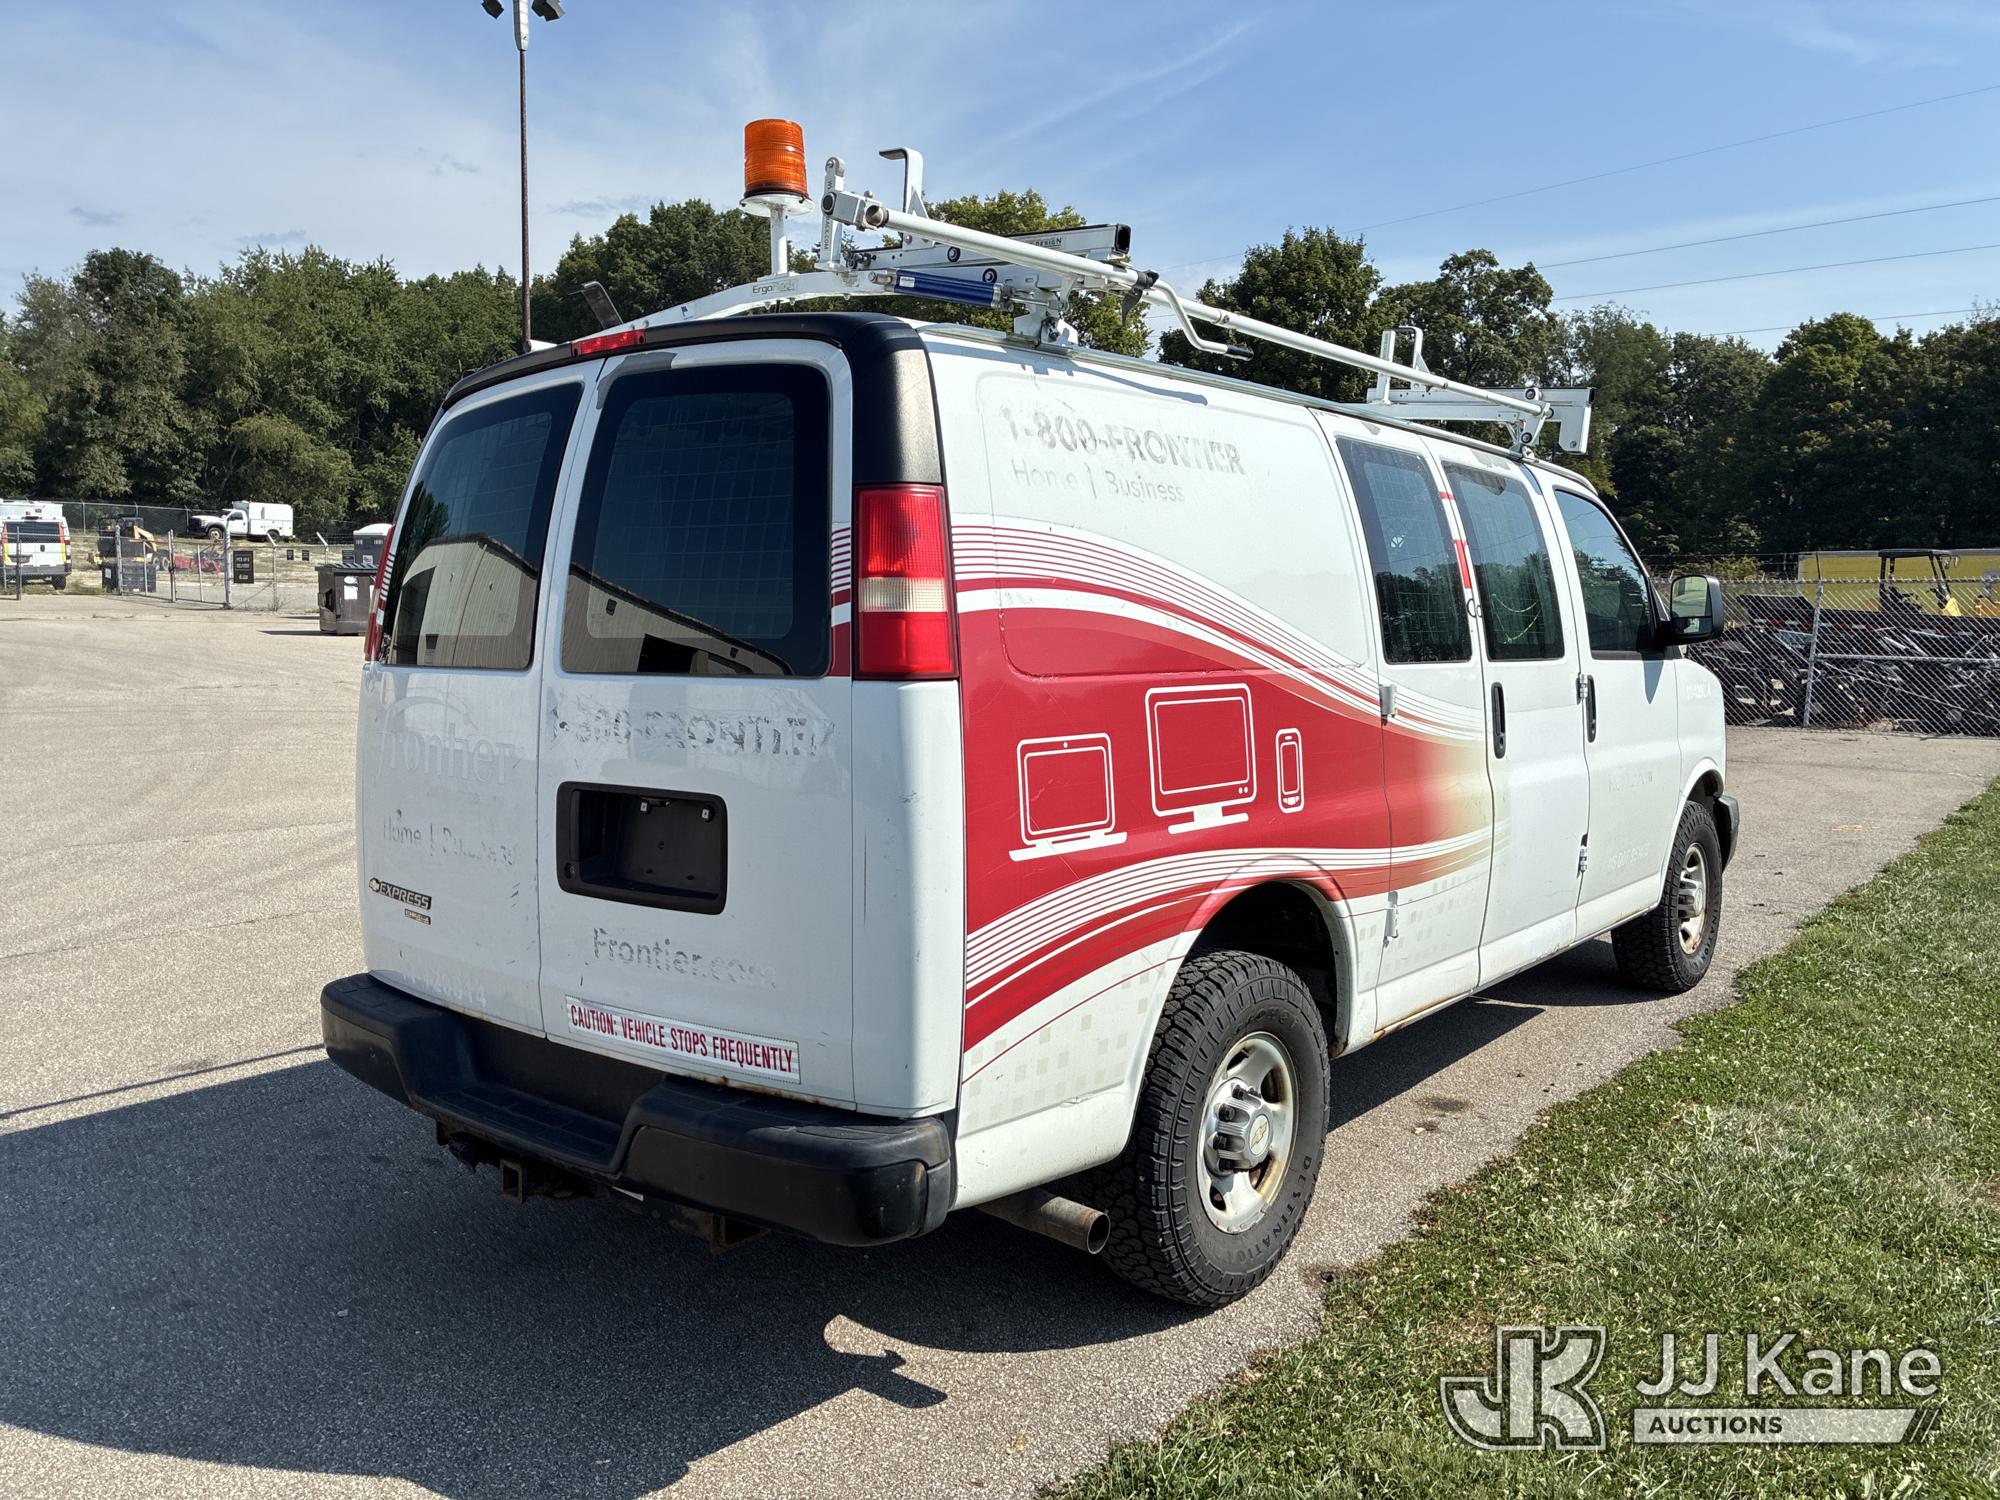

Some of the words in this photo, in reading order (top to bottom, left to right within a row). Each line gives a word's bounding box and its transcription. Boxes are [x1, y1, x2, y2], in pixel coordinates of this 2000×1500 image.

[1105, 470, 1184, 502] Business
[380, 882, 430, 910] EXPRESS
[571, 1004, 618, 1037] CAUTION:
[621, 1016, 666, 1048] VEHICLE
[671, 1027, 708, 1057] STOPS
[712, 1036, 793, 1073] FREQUENTLY
